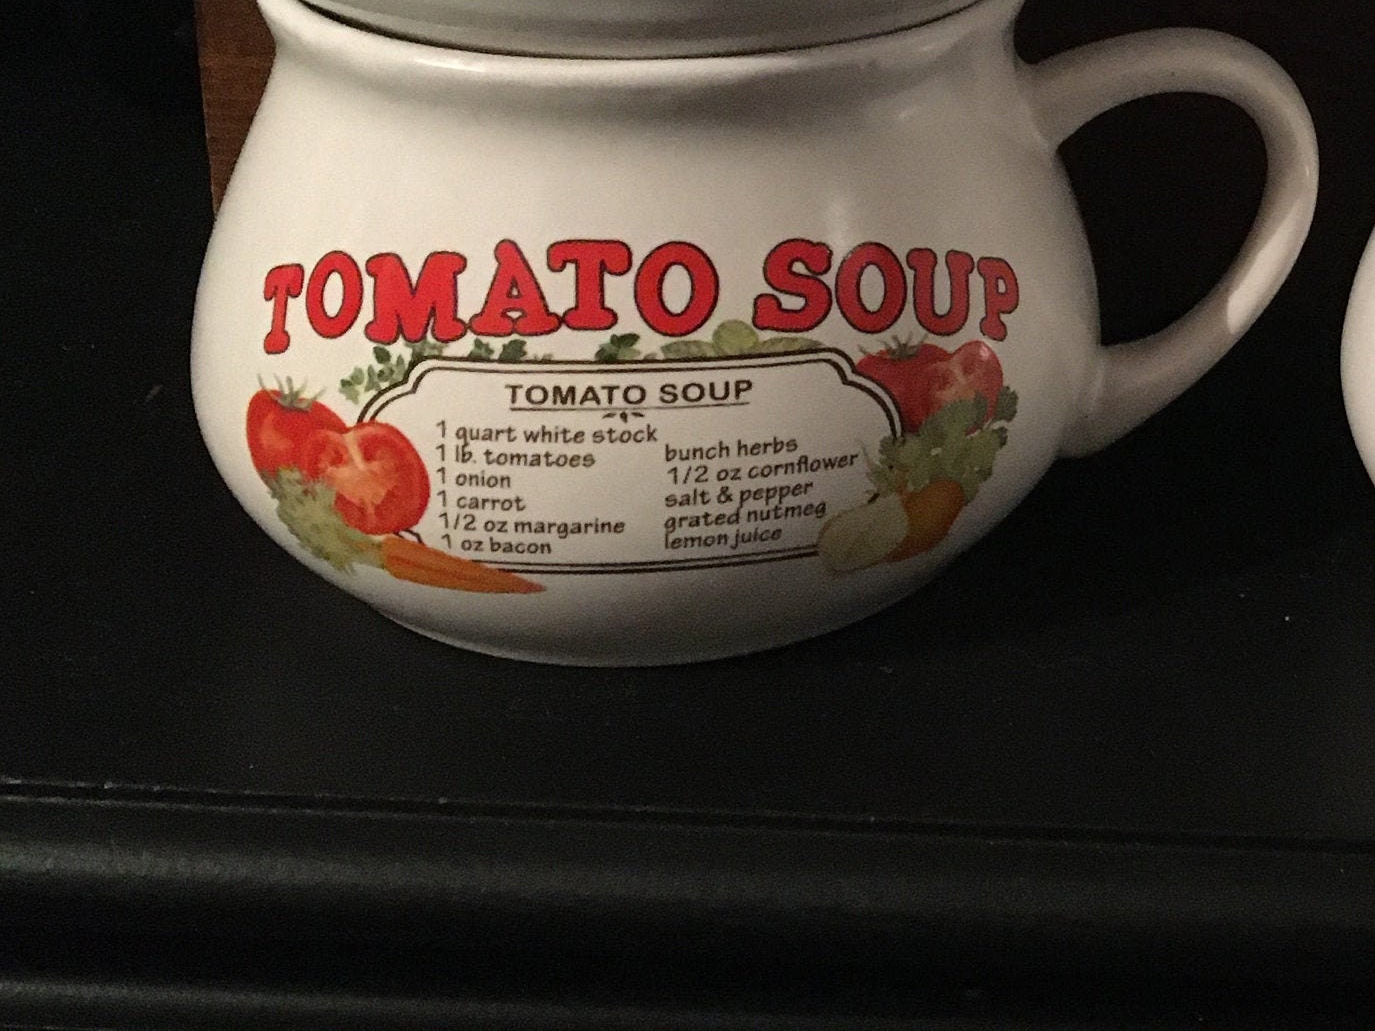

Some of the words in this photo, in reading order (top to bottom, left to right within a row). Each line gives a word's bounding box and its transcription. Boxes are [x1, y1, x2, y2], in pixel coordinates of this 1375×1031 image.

[262, 238, 721, 354] TOMATO
[753, 237, 1020, 341] SOUP
[505, 383, 647, 406] TOMATO
[659, 379, 754, 403] SOUP
[436, 420, 447, 438] 1
[455, 423, 517, 451] quart
[523, 427, 586, 444] white
[592, 424, 658, 444] stock
[436, 445, 446, 462] 1
[455, 446, 476, 465] lb.
[485, 451, 595, 467] tomatoes
[665, 442, 730, 462] bunch
[737, 436, 798, 455] herbs
[436, 468, 446, 485] 1
[455, 472, 512, 488] onion
[667, 465, 709, 485] 1/2
[716, 467, 741, 481] oz
[748, 453, 859, 479] cornflower
[436, 491, 447, 507] 1
[456, 495, 527, 512] carrot
[664, 488, 712, 508] salt
[717, 486, 733, 503] &
[739, 481, 814, 510] pepper
[438, 513, 477, 531] 1/2
[484, 519, 508, 533] oz
[513, 518, 626, 538] margarine
[664, 506, 740, 533] grated
[747, 501, 827, 524] nutmeg
[441, 535, 452, 550] 1
[461, 540, 484, 553] oz
[489, 537, 552, 555] bacon
[665, 533, 729, 551] lemon
[732, 526, 782, 550] juice
